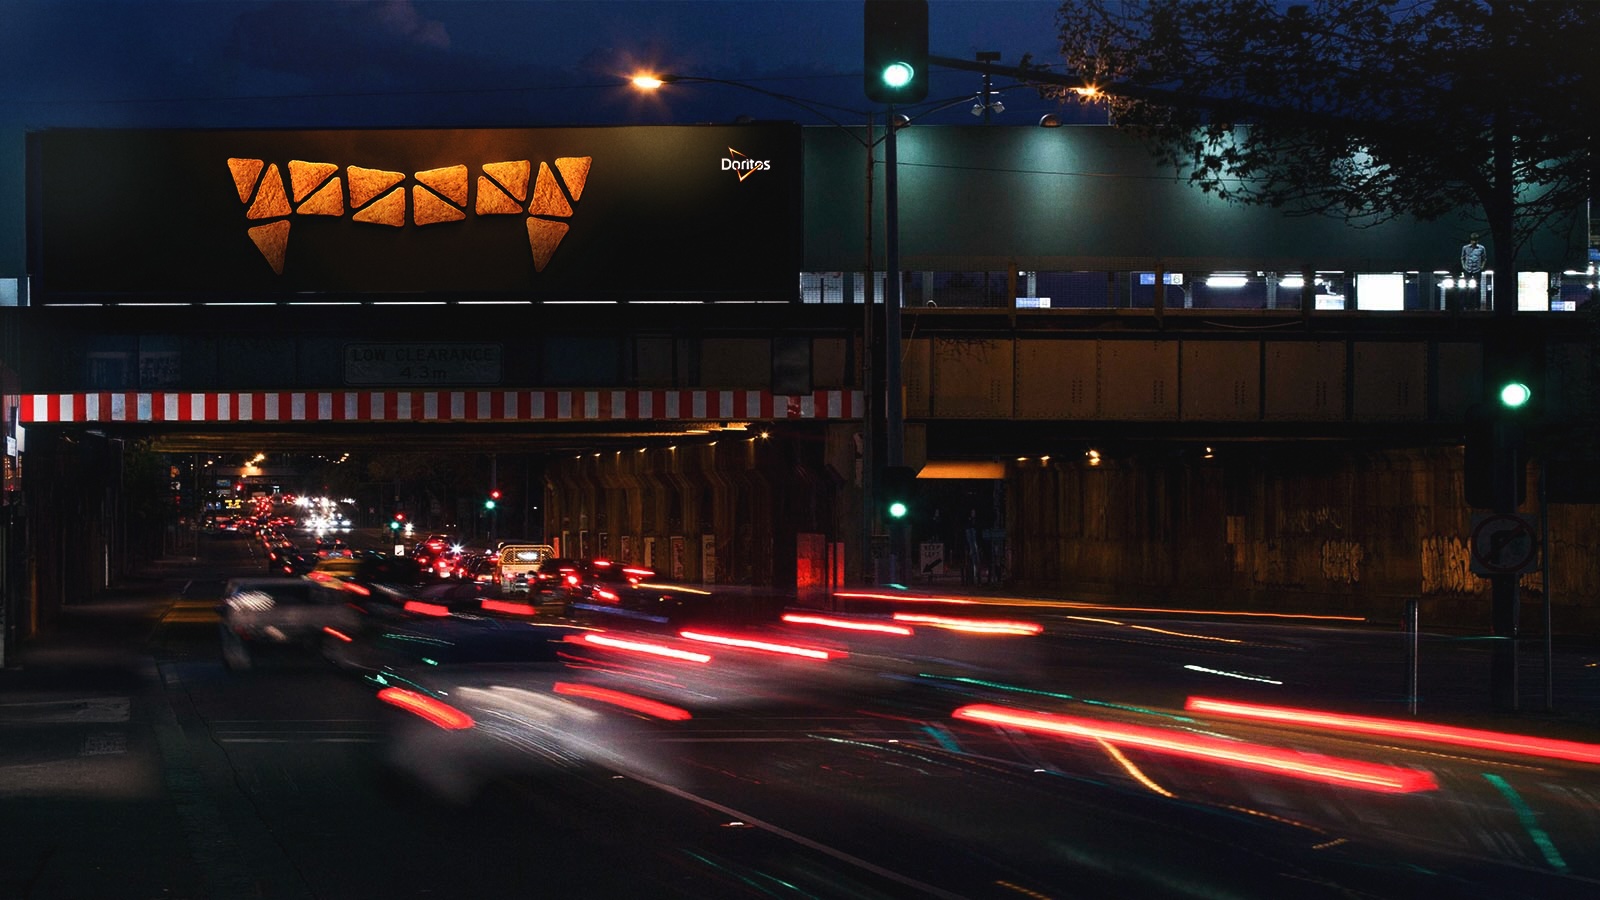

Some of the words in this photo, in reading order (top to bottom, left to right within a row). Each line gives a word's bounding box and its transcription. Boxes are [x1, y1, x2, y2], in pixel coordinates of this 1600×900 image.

[721, 158, 771, 171] Doritos
[353, 349, 386, 361] LOW
[395, 349, 494, 361] CLEARANCE
